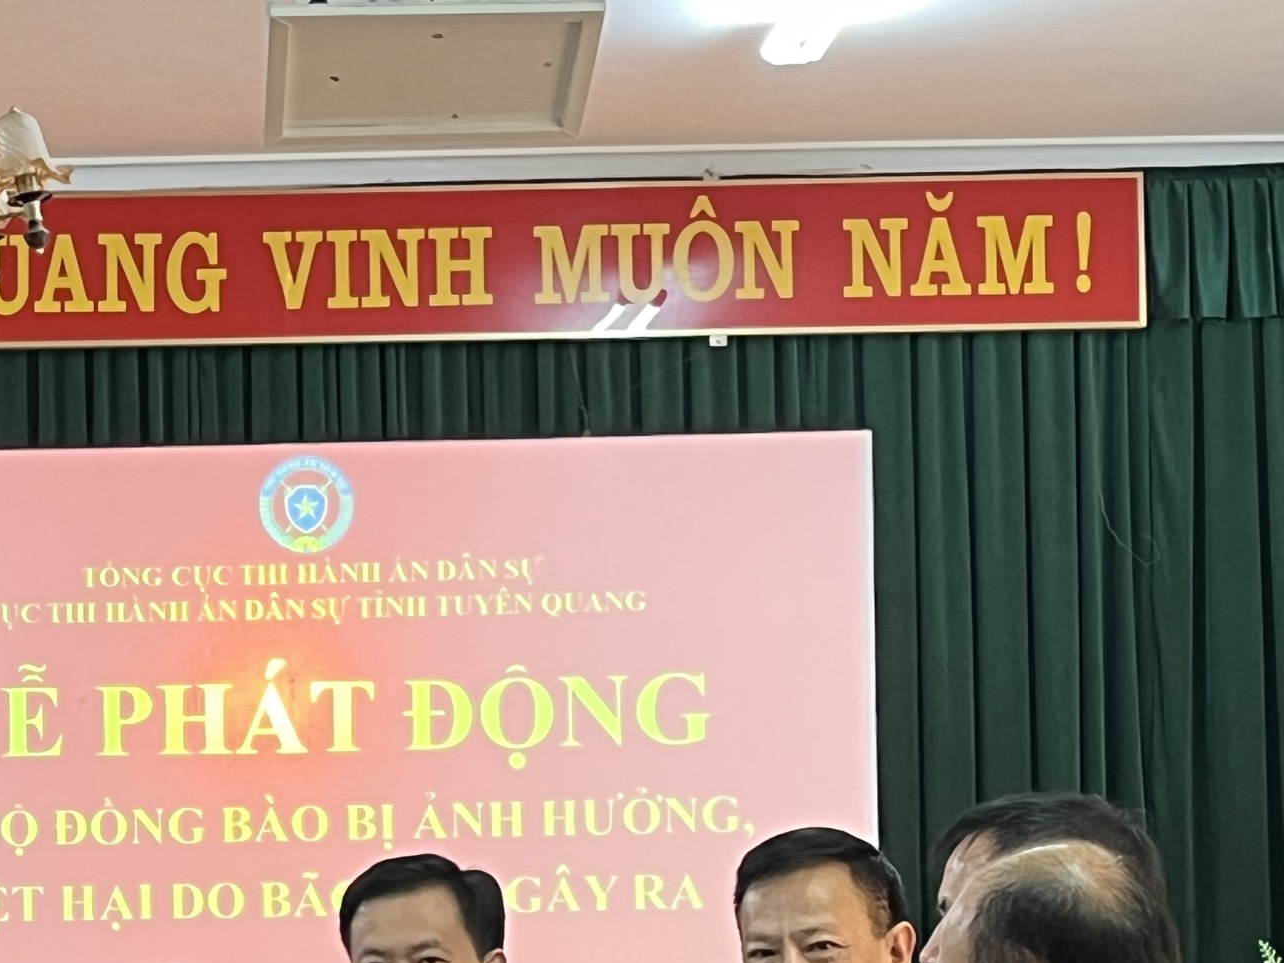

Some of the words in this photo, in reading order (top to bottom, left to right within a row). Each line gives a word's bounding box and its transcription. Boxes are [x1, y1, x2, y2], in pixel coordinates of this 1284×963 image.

[262, 226, 494, 311] VINH
[534, 195, 801, 307] MUÔN
[171, 564, 233, 593] CỤC
[238, 562, 288, 587] THI
[297, 556, 381, 585] HÀNH
[437, 552, 498, 582] DÂN
[504, 555, 544, 586] SỰ
[47, 601, 97, 625] THI
[106, 595, 189, 624] HÀNH
[245, 591, 305, 622] DÂN
[311, 595, 351, 626] SỰ
[436, 586, 534, 617] TUYÊN
[541, 589, 648, 617] QUANG
[95, 657, 376, 757] PHÁT
[402, 663, 713, 770] ĐỘNG
[55, 796, 205, 847] ĐỒNG
[222, 794, 329, 844] BÀO
[347, 803, 396, 851] BỊ
[413, 790, 524, 840] ẢNH
[543, 787, 756, 838] HƯỞNG,
[62, 883, 163, 931] HẠI
[172, 881, 245, 921] DO
[505, 864, 619, 914] GÂY
[634, 873, 705, 912] RA
